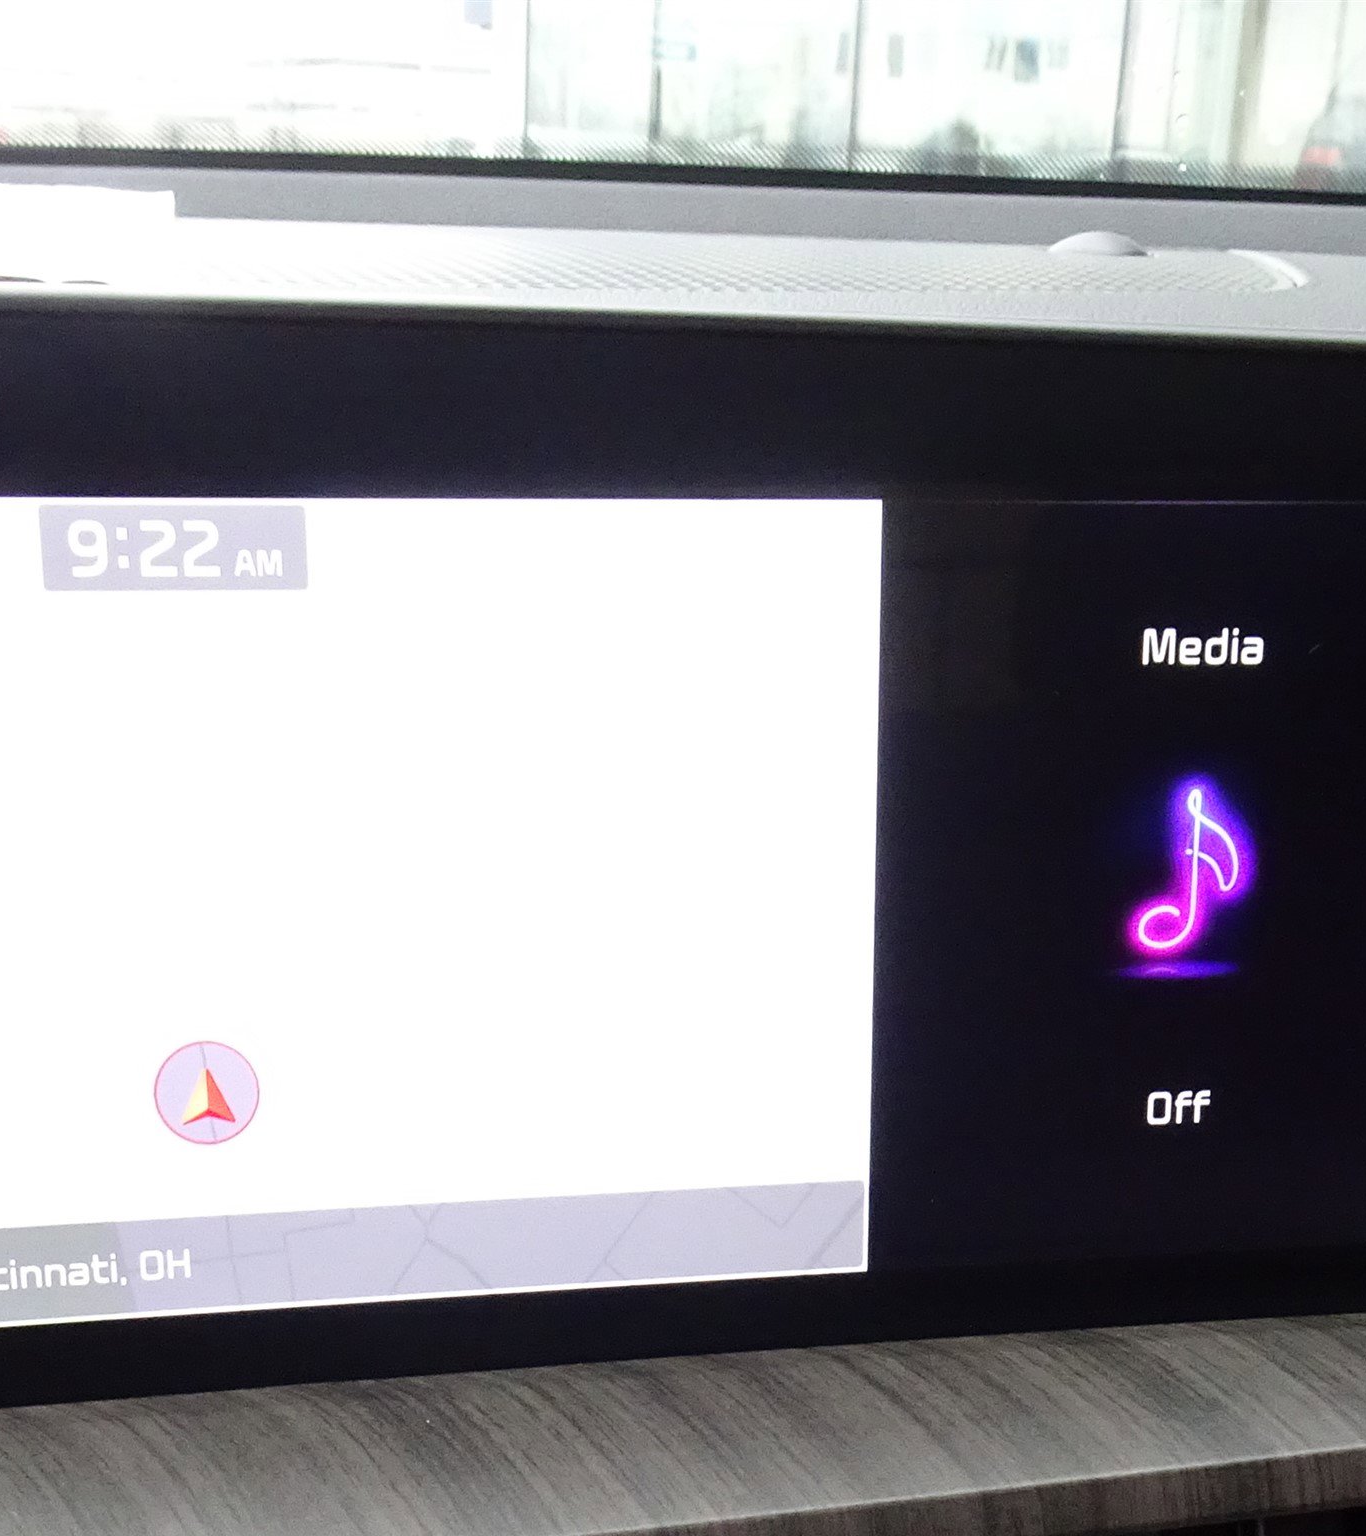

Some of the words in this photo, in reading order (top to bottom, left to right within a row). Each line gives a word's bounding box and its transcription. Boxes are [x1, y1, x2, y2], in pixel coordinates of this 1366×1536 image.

[67, 519, 221, 578] 9:22
[234, 549, 284, 577] AM
[1141, 627, 1265, 666] Media
[1146, 1089, 1212, 1126] Off
[138, 1248, 193, 1283] OH
